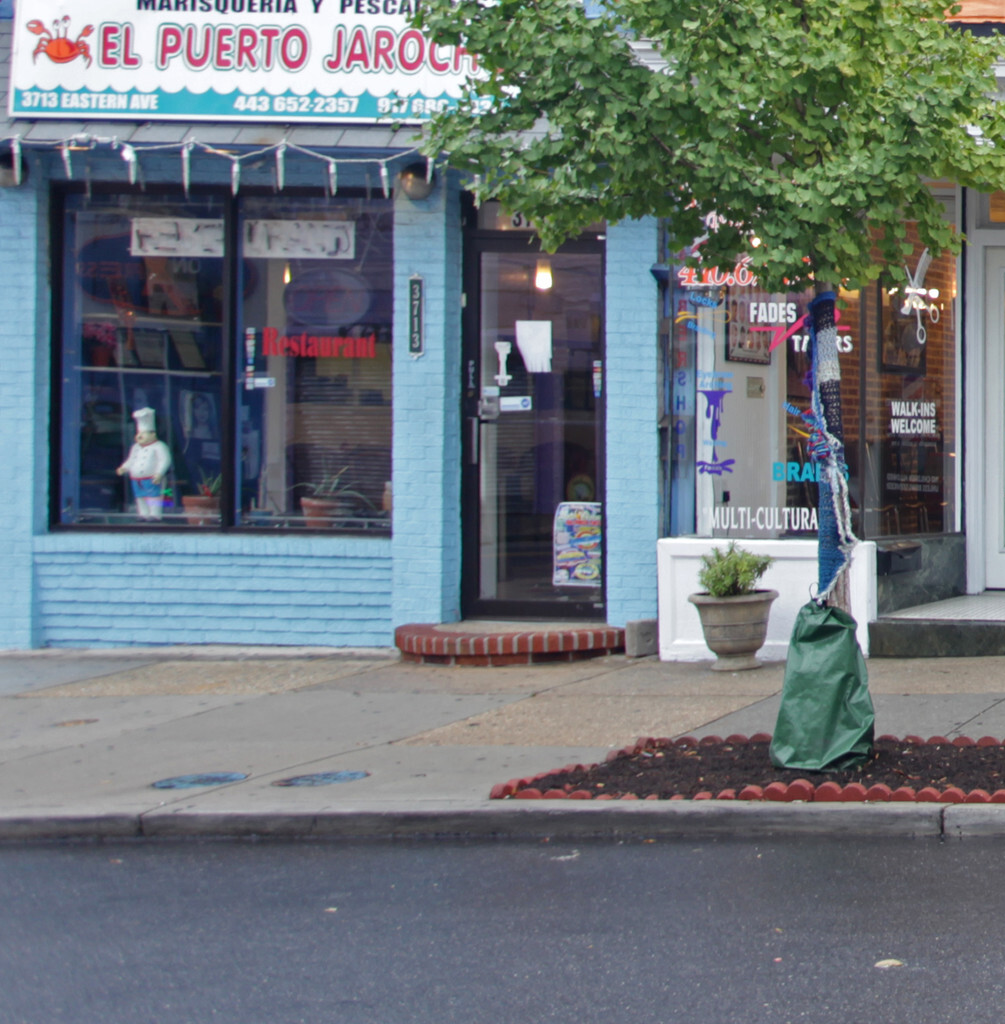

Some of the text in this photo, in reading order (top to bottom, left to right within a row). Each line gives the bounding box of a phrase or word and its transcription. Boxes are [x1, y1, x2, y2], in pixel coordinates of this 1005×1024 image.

[99, 23, 142, 69] EL
[157, 23, 310, 72] PUERTO
[21, 92, 158, 110] 3713 EASTERN AVE
[234, 95, 270, 112] 443
[273, 97, 359, 114] 652-2357
[412, 284, 421, 349] 3713
[750, 302, 797, 323] FADES
[262, 327, 376, 358] Restaurant
[891, 401, 936, 416] WALK-INS
[891, 418, 936, 433] WELCOME
